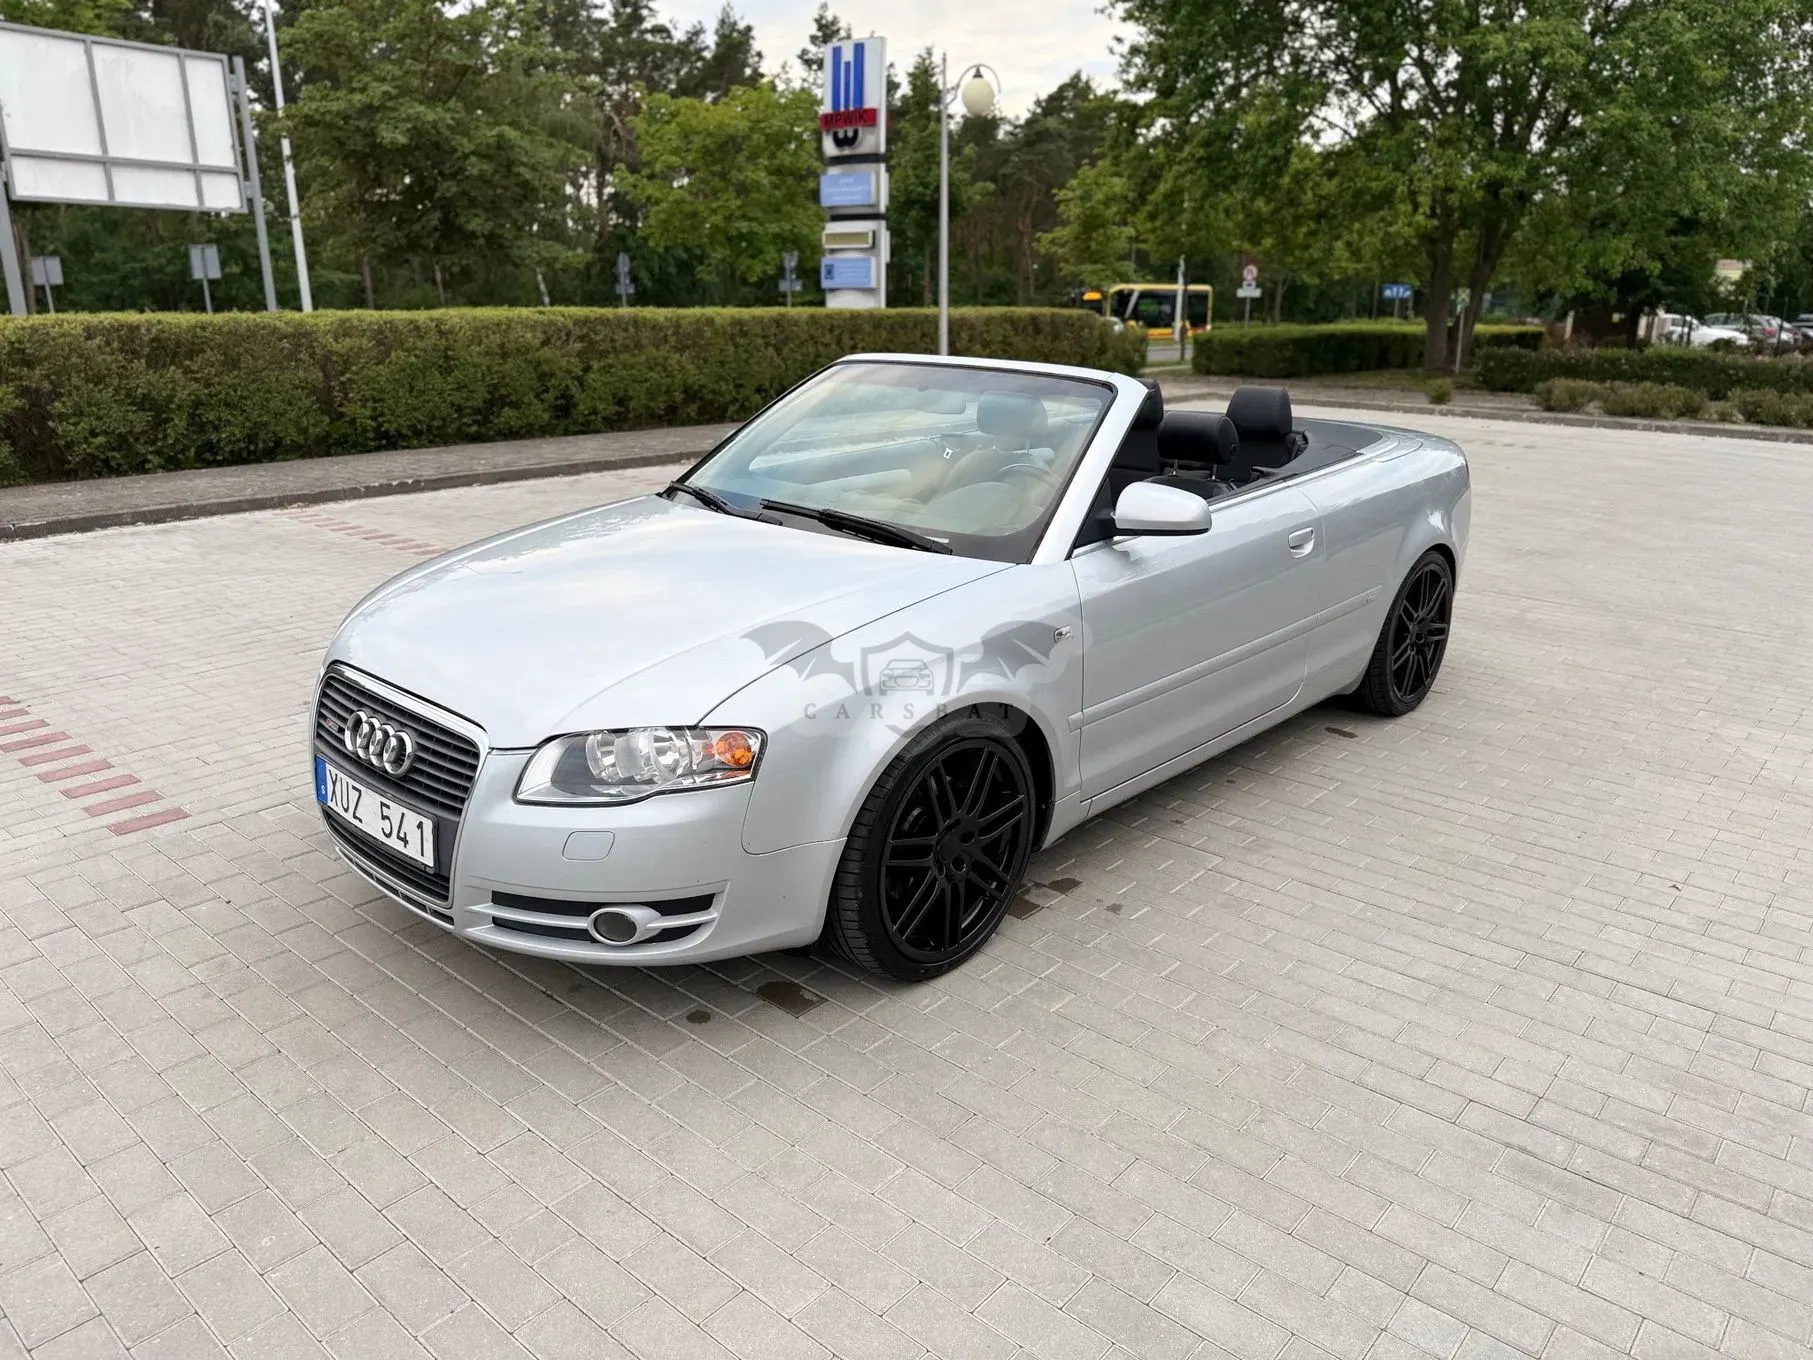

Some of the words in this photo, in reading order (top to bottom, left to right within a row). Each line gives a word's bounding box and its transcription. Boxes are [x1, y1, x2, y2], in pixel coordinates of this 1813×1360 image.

[321, 784, 326, 794] S
[328, 768, 363, 824] XUZ
[380, 800, 424, 857] 541
